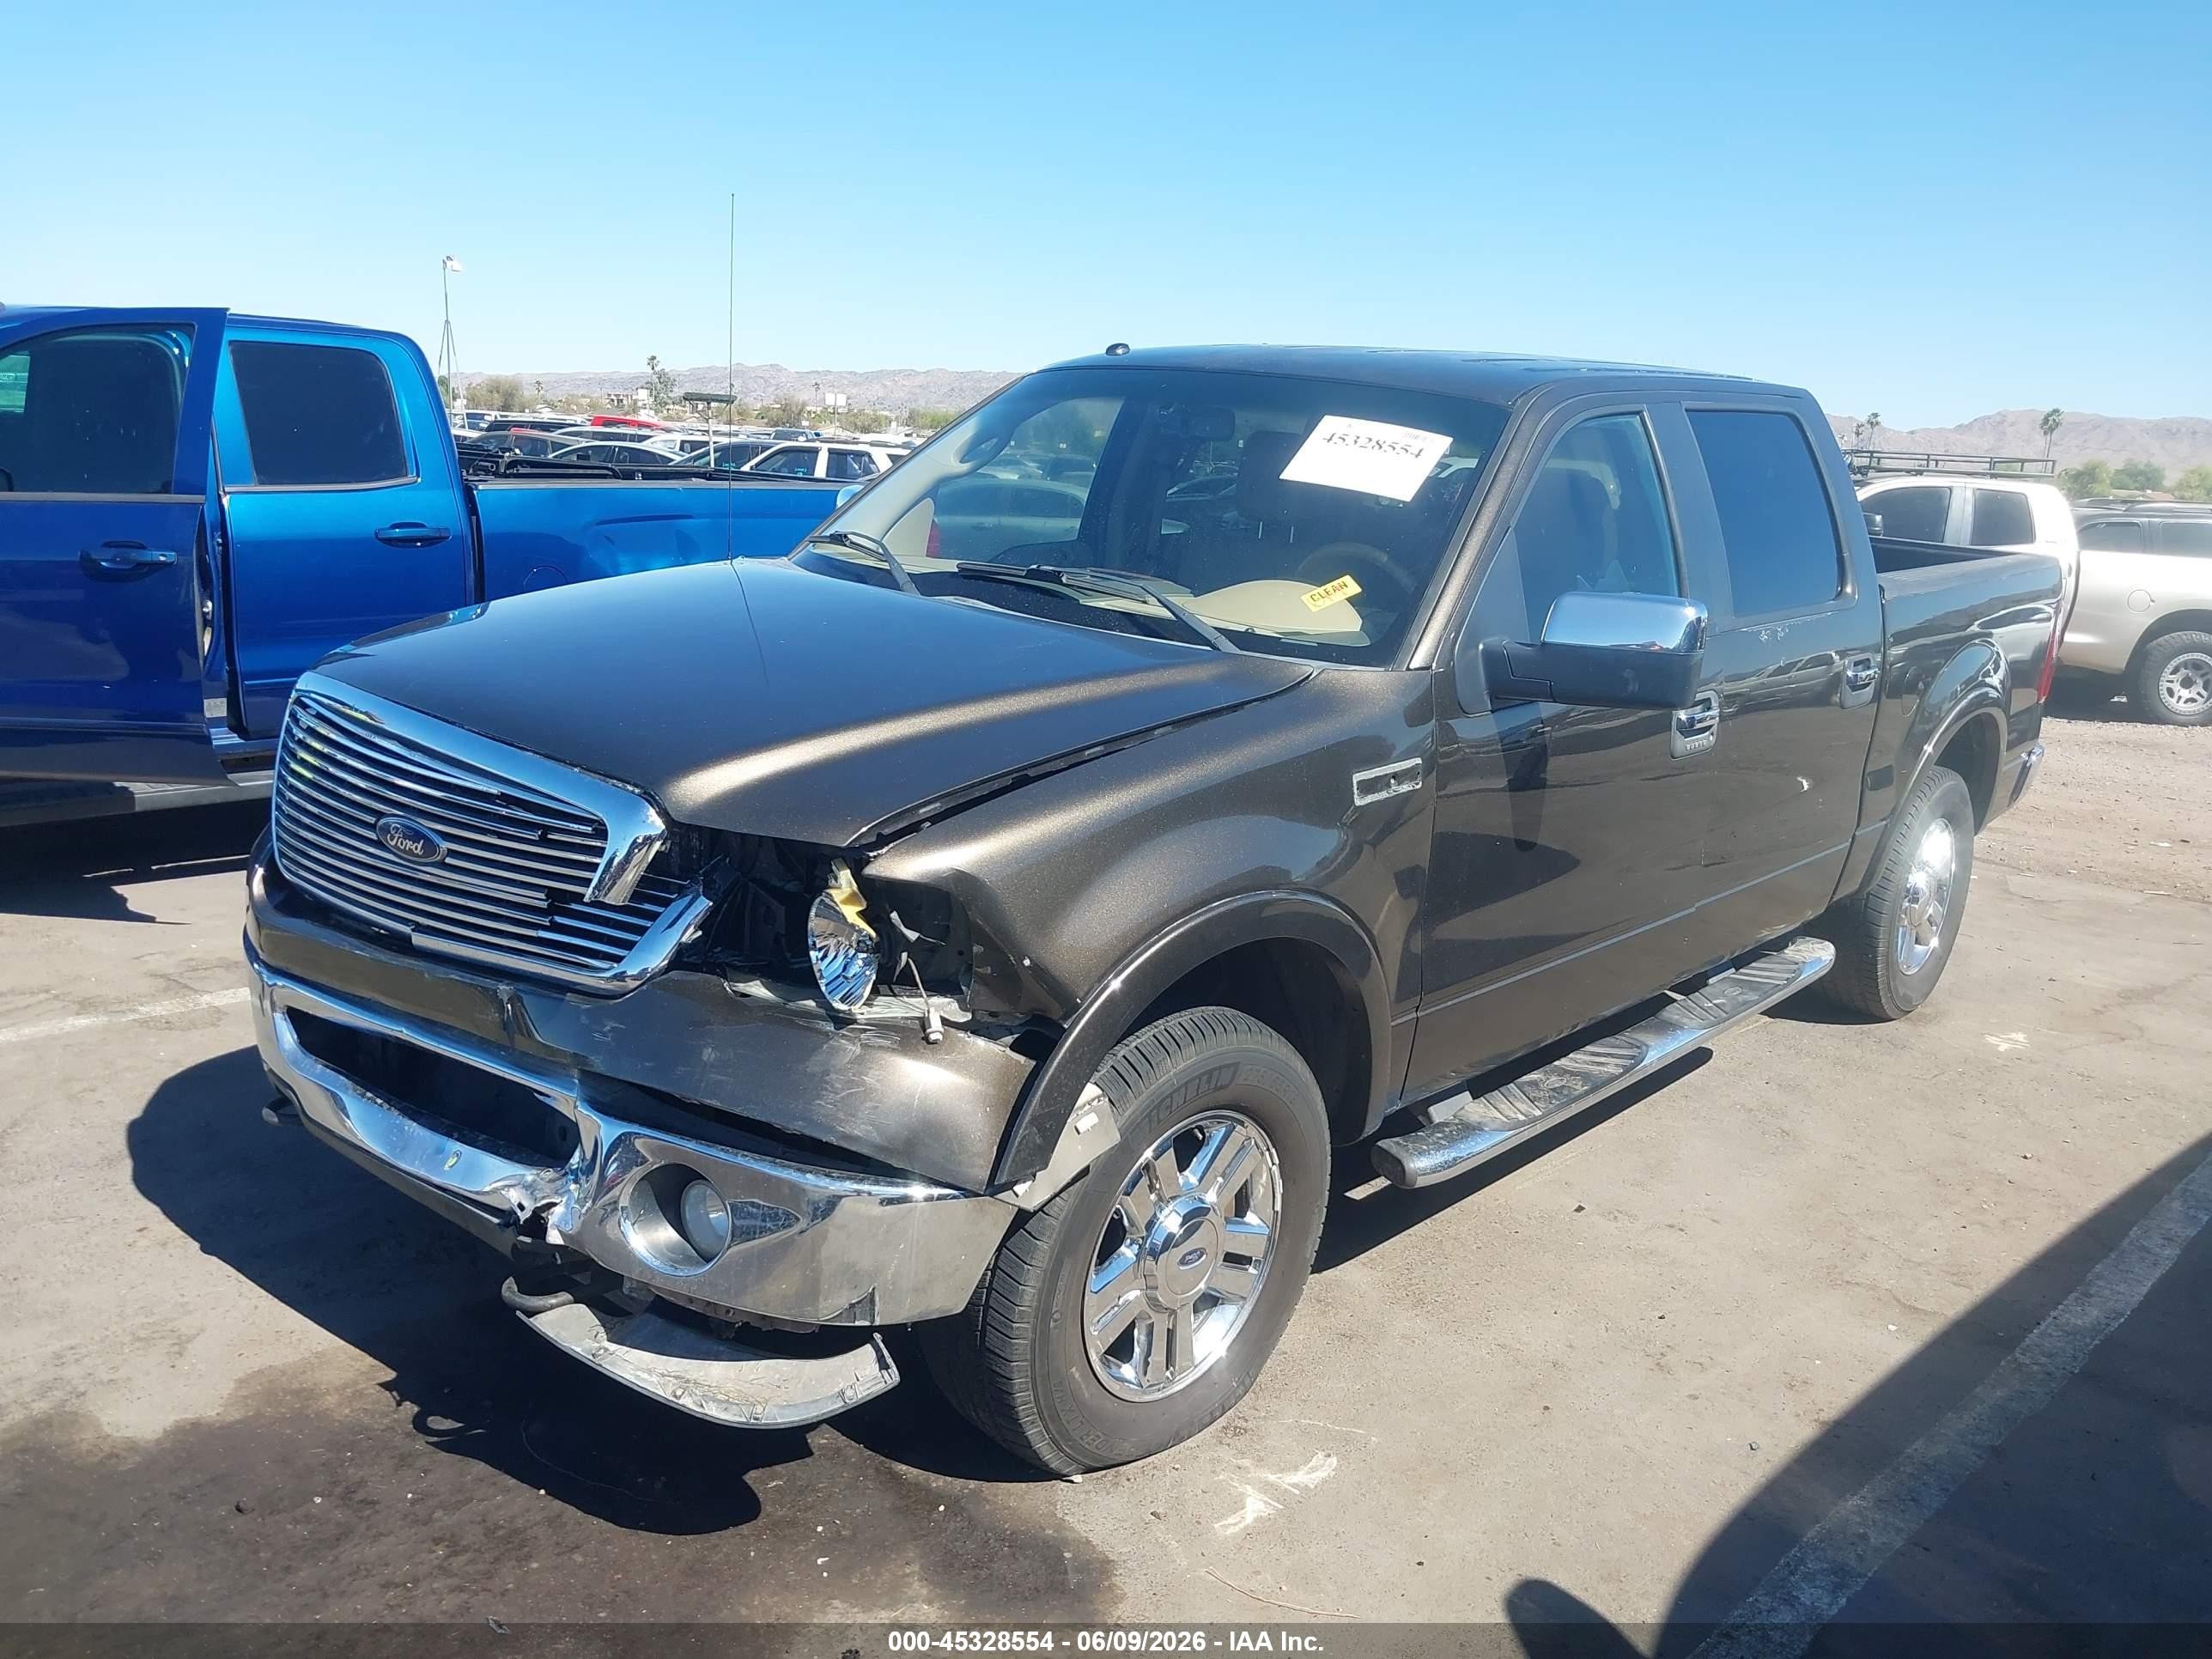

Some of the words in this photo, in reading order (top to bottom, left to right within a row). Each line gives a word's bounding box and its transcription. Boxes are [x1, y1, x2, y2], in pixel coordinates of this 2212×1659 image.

[1322, 432, 1425, 459] 45328554
[1310, 580, 1349, 602] CLEAN
[387, 823, 424, 855] Ford
